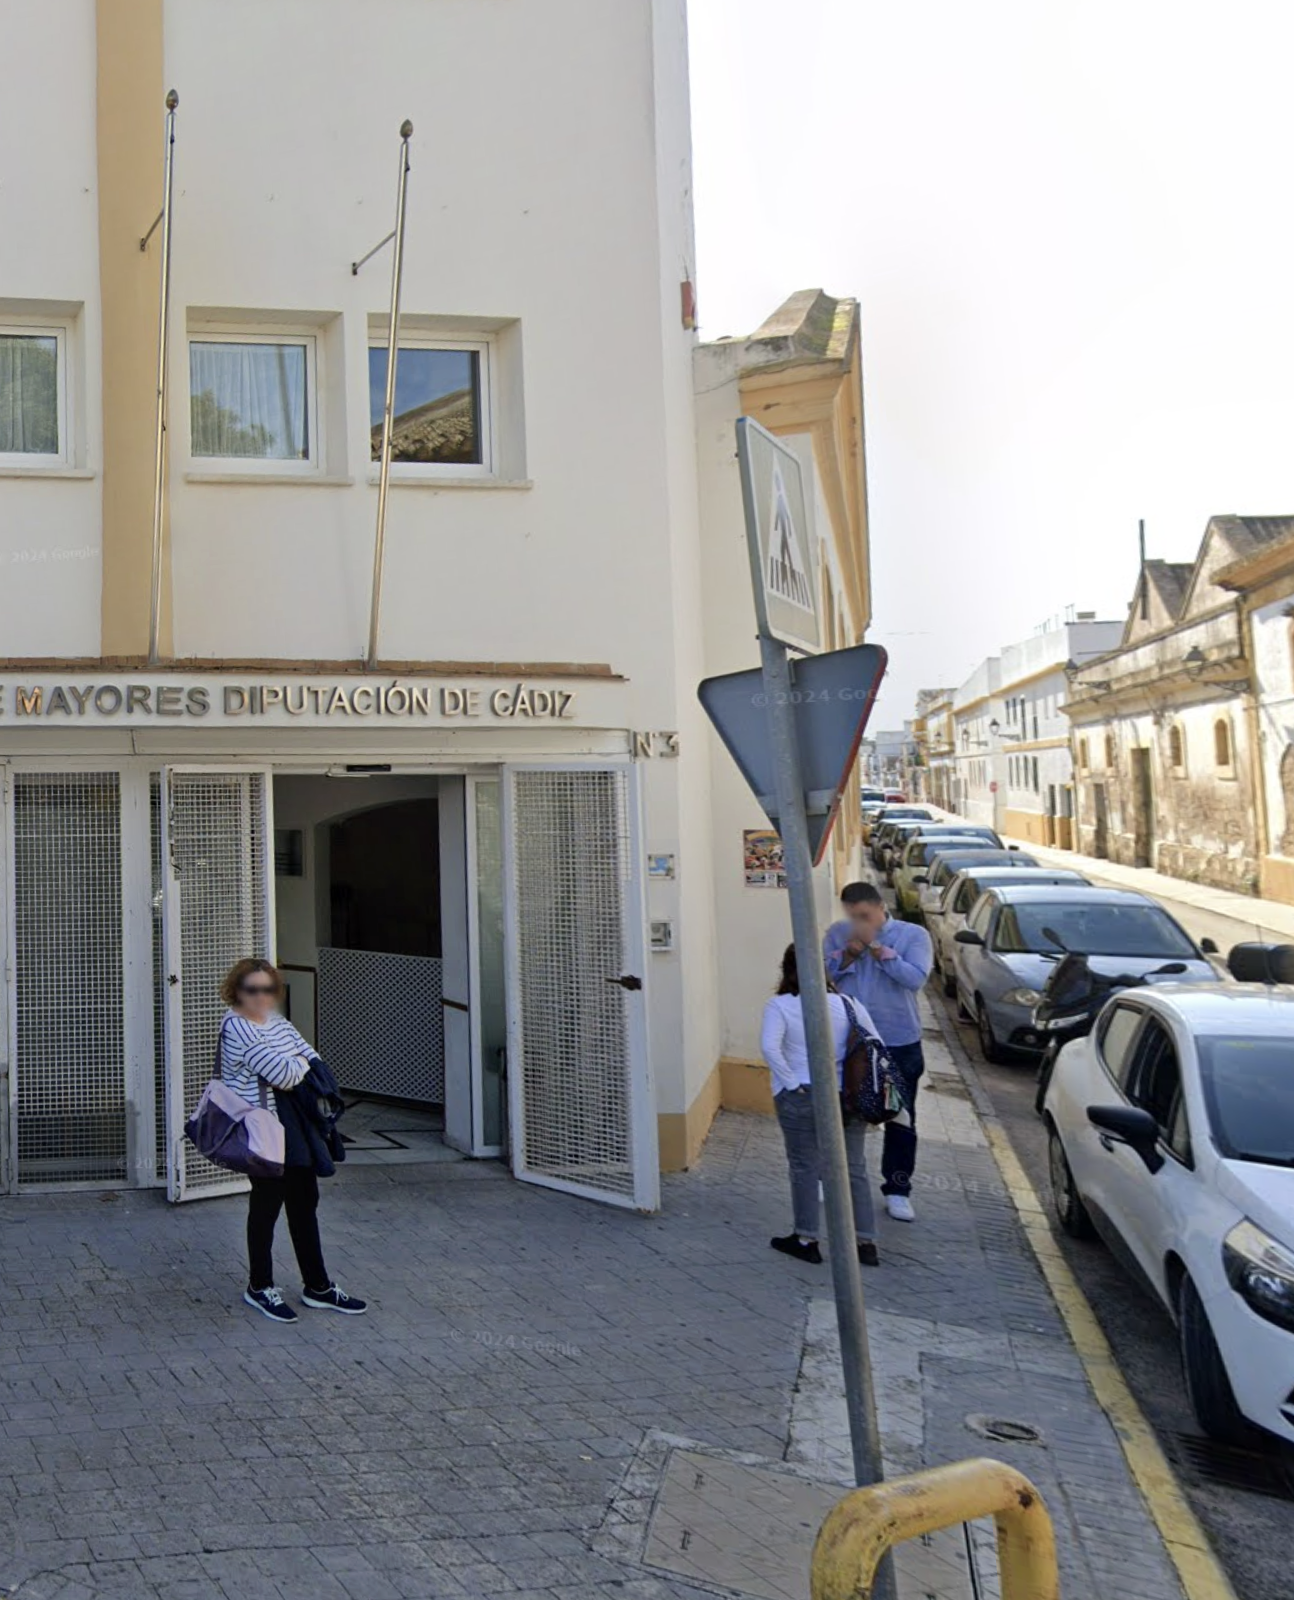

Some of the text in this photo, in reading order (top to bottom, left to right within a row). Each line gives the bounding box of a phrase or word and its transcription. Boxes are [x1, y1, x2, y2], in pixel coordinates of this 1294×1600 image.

[15, 684, 212, 717] MAYORES
[223, 679, 431, 717] DIPUTACIÓN
[442, 686, 482, 717] DE
[491, 681, 578, 719] CÁDIZ
